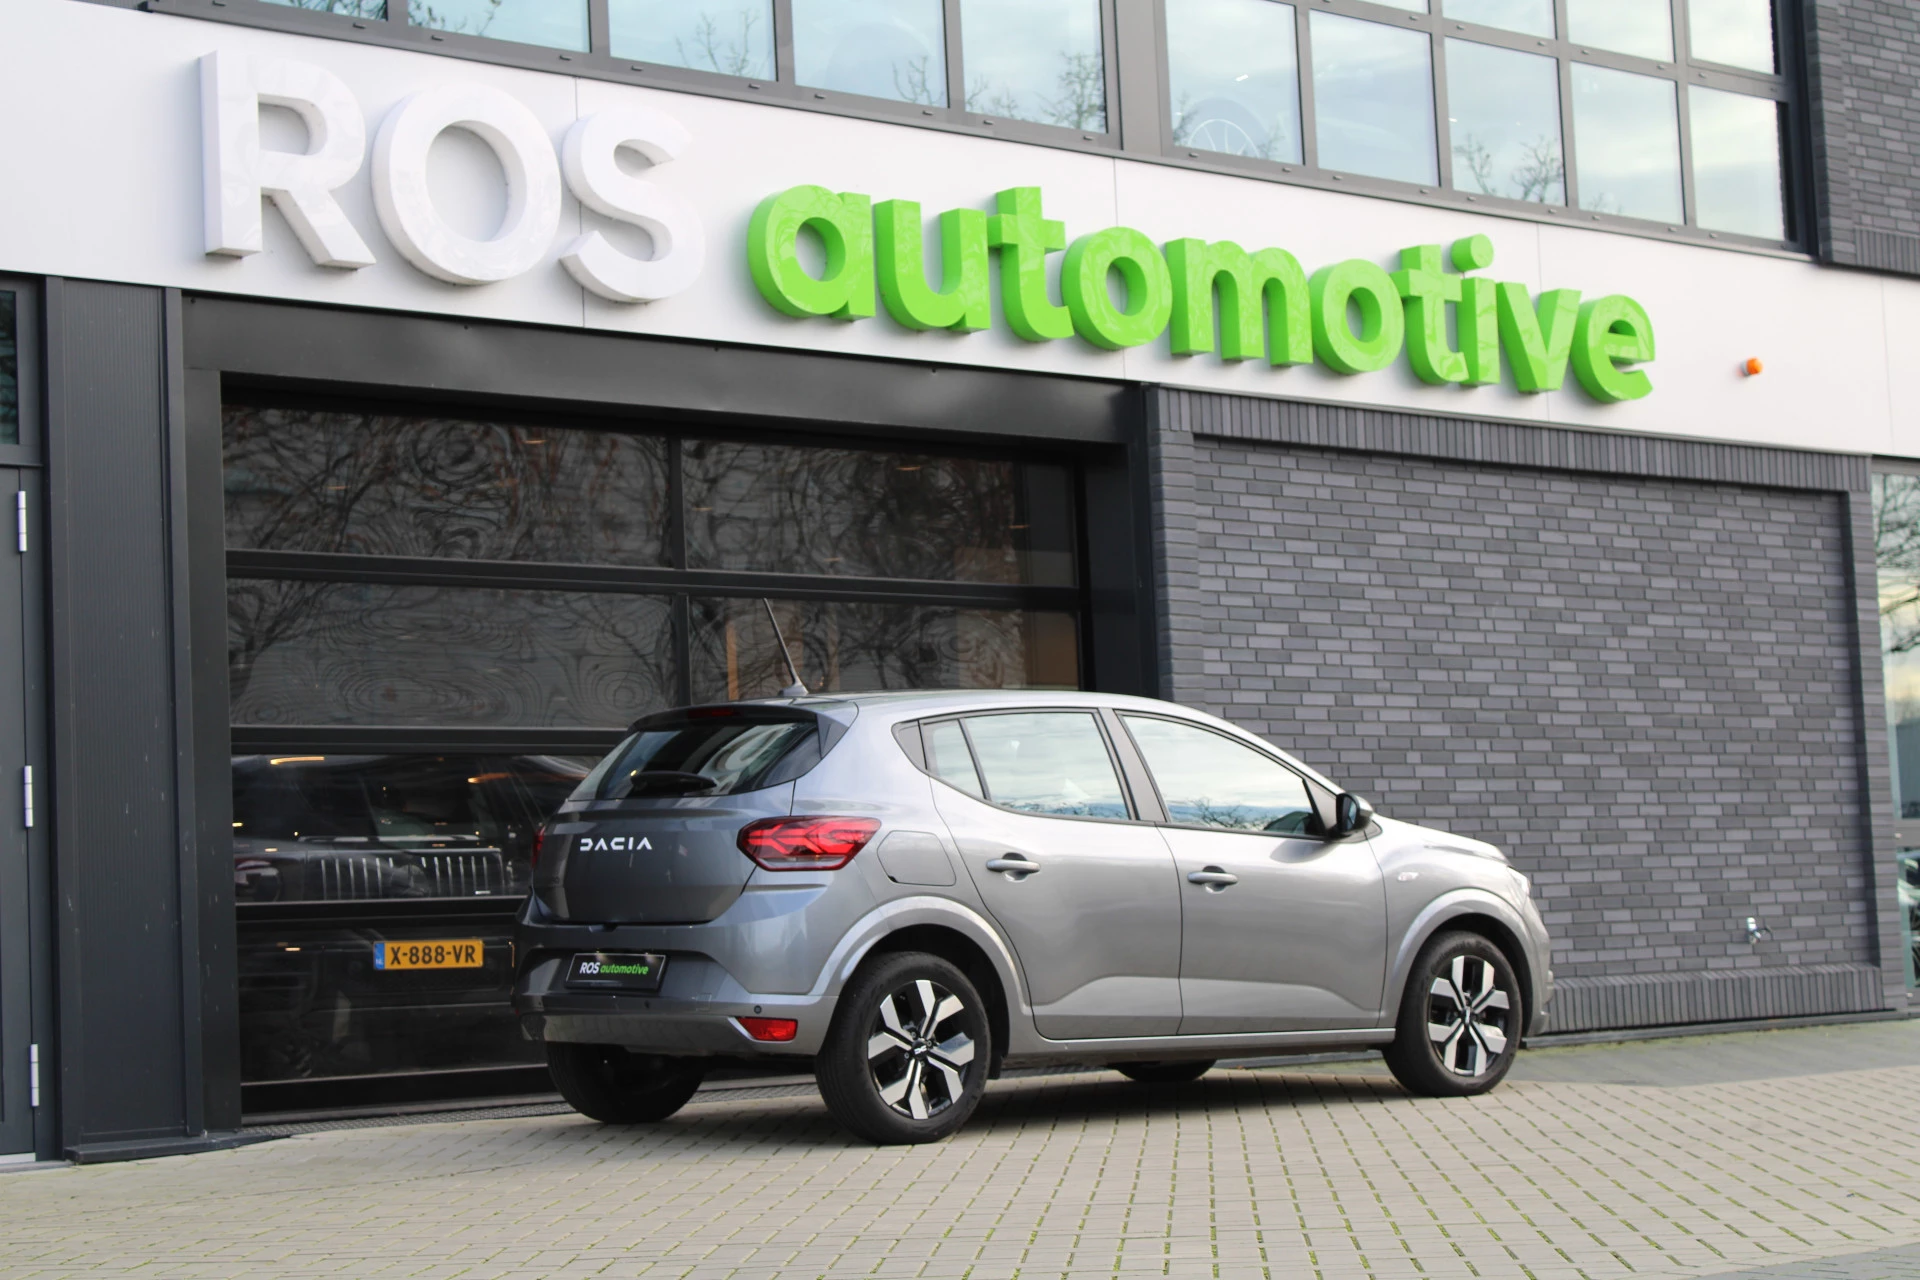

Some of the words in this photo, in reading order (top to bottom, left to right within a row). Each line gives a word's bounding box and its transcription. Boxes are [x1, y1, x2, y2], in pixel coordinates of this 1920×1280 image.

[201, 50, 705, 305] ROS
[747, 184, 1655, 403] automotive
[579, 837, 653, 851] DACIA
[390, 945, 476, 966] X-888-VR
[579, 961, 600, 975] ROS
[600, 963, 649, 975] automotive
